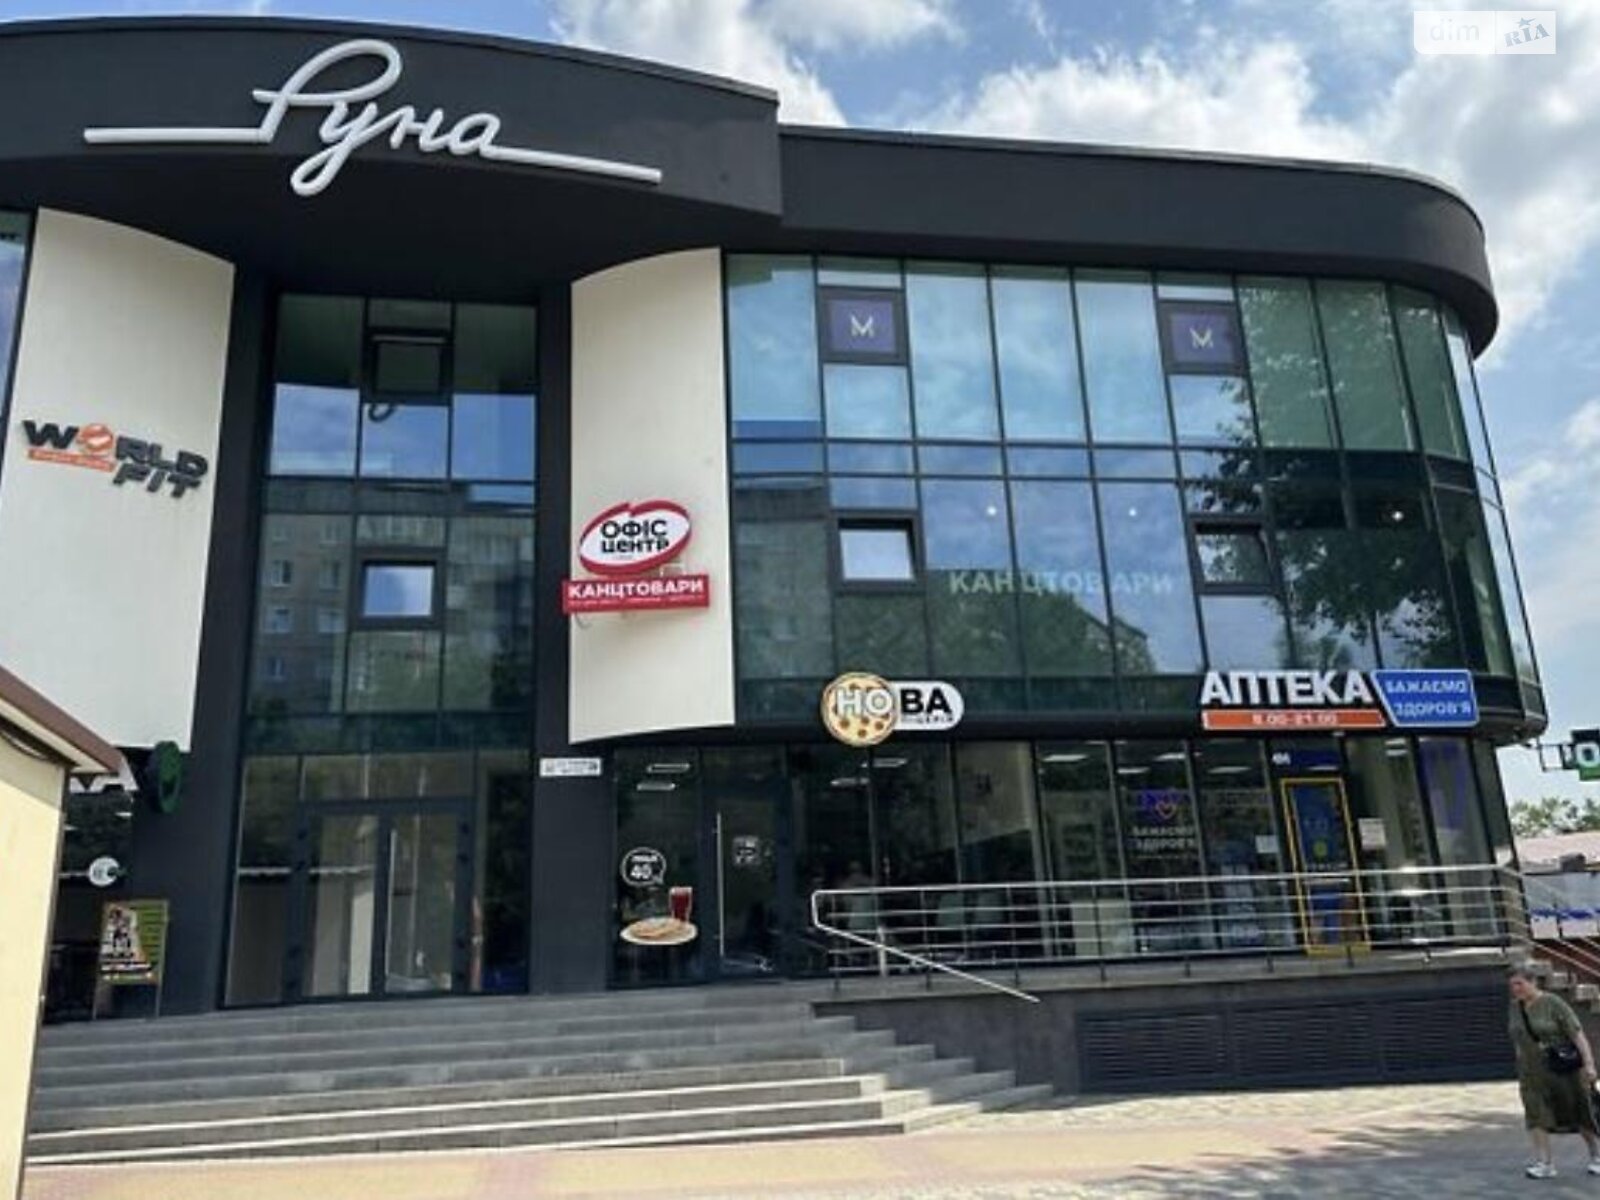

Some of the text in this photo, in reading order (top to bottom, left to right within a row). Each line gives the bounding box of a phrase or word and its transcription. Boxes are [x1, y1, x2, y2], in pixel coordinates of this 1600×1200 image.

[22, 420, 209, 477] WORLD
[113, 462, 202, 499] FIT
[601, 519, 668, 539] ОФІС
[567, 579, 704, 599] КАНЦТОВАРИ
[950, 570, 1174, 596] КАНЦТОВАРИ
[1201, 670, 1373, 705] АПТЕКА
[1385, 679, 1467, 694] БАЖАЄМО
[836, 687, 952, 716] НОВА
